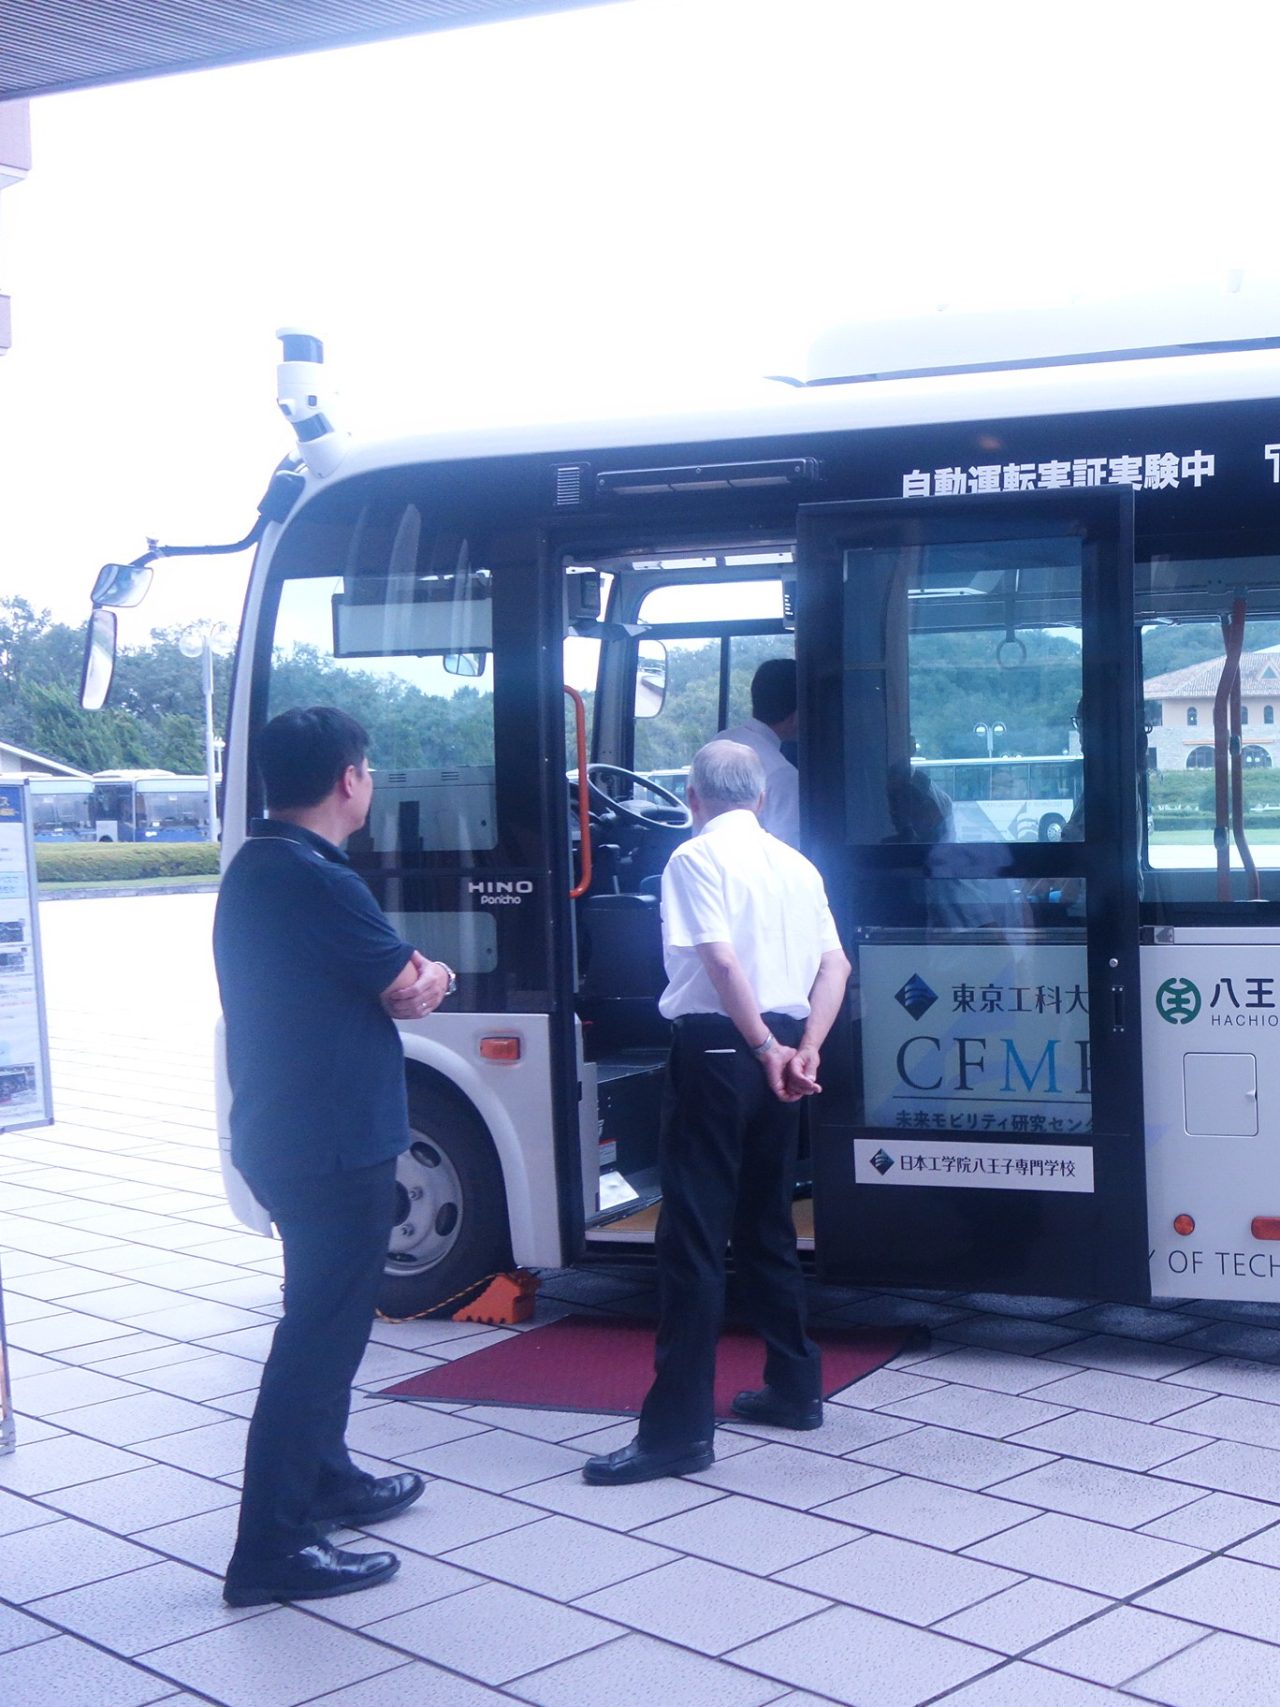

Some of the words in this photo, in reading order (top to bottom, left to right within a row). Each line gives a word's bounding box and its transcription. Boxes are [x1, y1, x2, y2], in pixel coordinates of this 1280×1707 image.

[902, 450, 1216, 498] 自動運転実証実験中
[468, 880, 533, 893] HINO
[951, 983, 1089, 1014] 東京工科大
[900, 1155, 1076, 1177] 日本工学院八王子専門学校
[1168, 1250, 1203, 1274] OF
